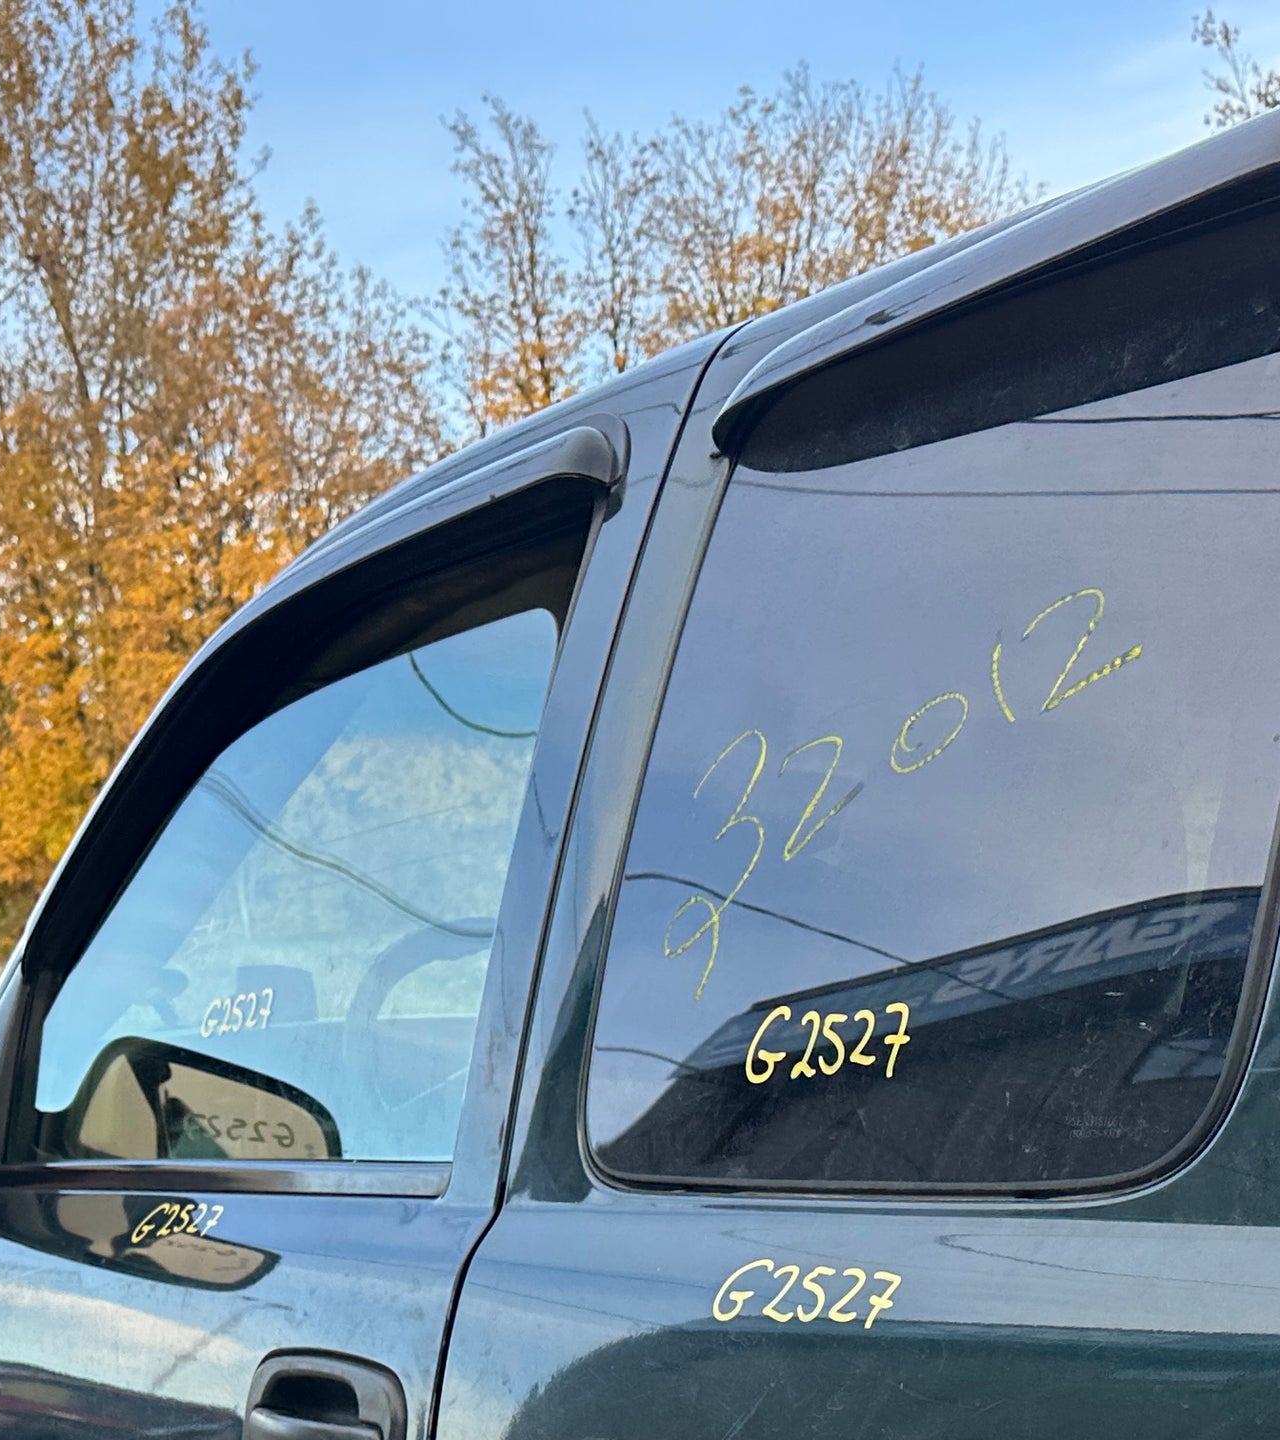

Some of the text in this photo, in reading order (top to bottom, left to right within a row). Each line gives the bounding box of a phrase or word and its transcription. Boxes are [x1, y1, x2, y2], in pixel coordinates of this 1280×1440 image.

[200, 987, 274, 1038] G2527
[744, 1001, 911, 1084] G2527
[130, 1202, 225, 1245] G2527
[712, 1258, 903, 1330] G2527
